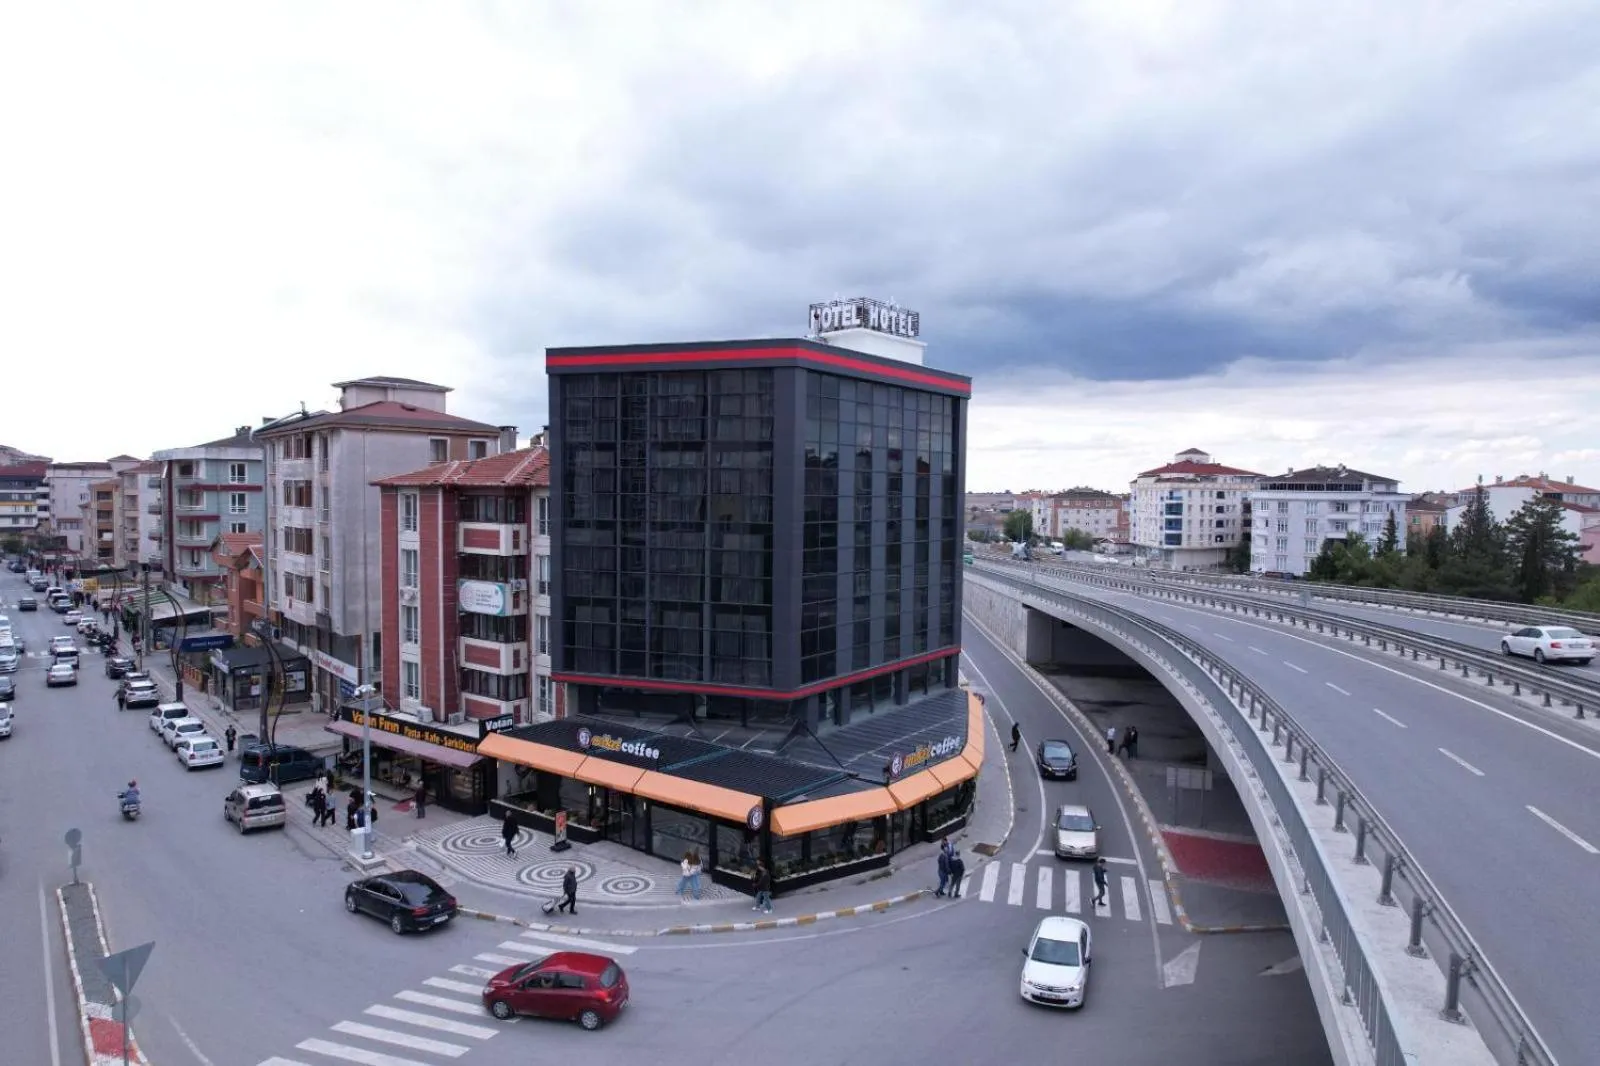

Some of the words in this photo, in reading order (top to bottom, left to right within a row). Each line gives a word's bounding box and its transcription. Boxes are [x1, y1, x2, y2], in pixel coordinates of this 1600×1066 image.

[810, 304, 860, 329] HOTEL
[869, 305, 915, 336] HOTEL
[485, 719, 513, 730] Vatan
[622, 742, 660, 759] coffee
[930, 736, 961, 757] coffee
